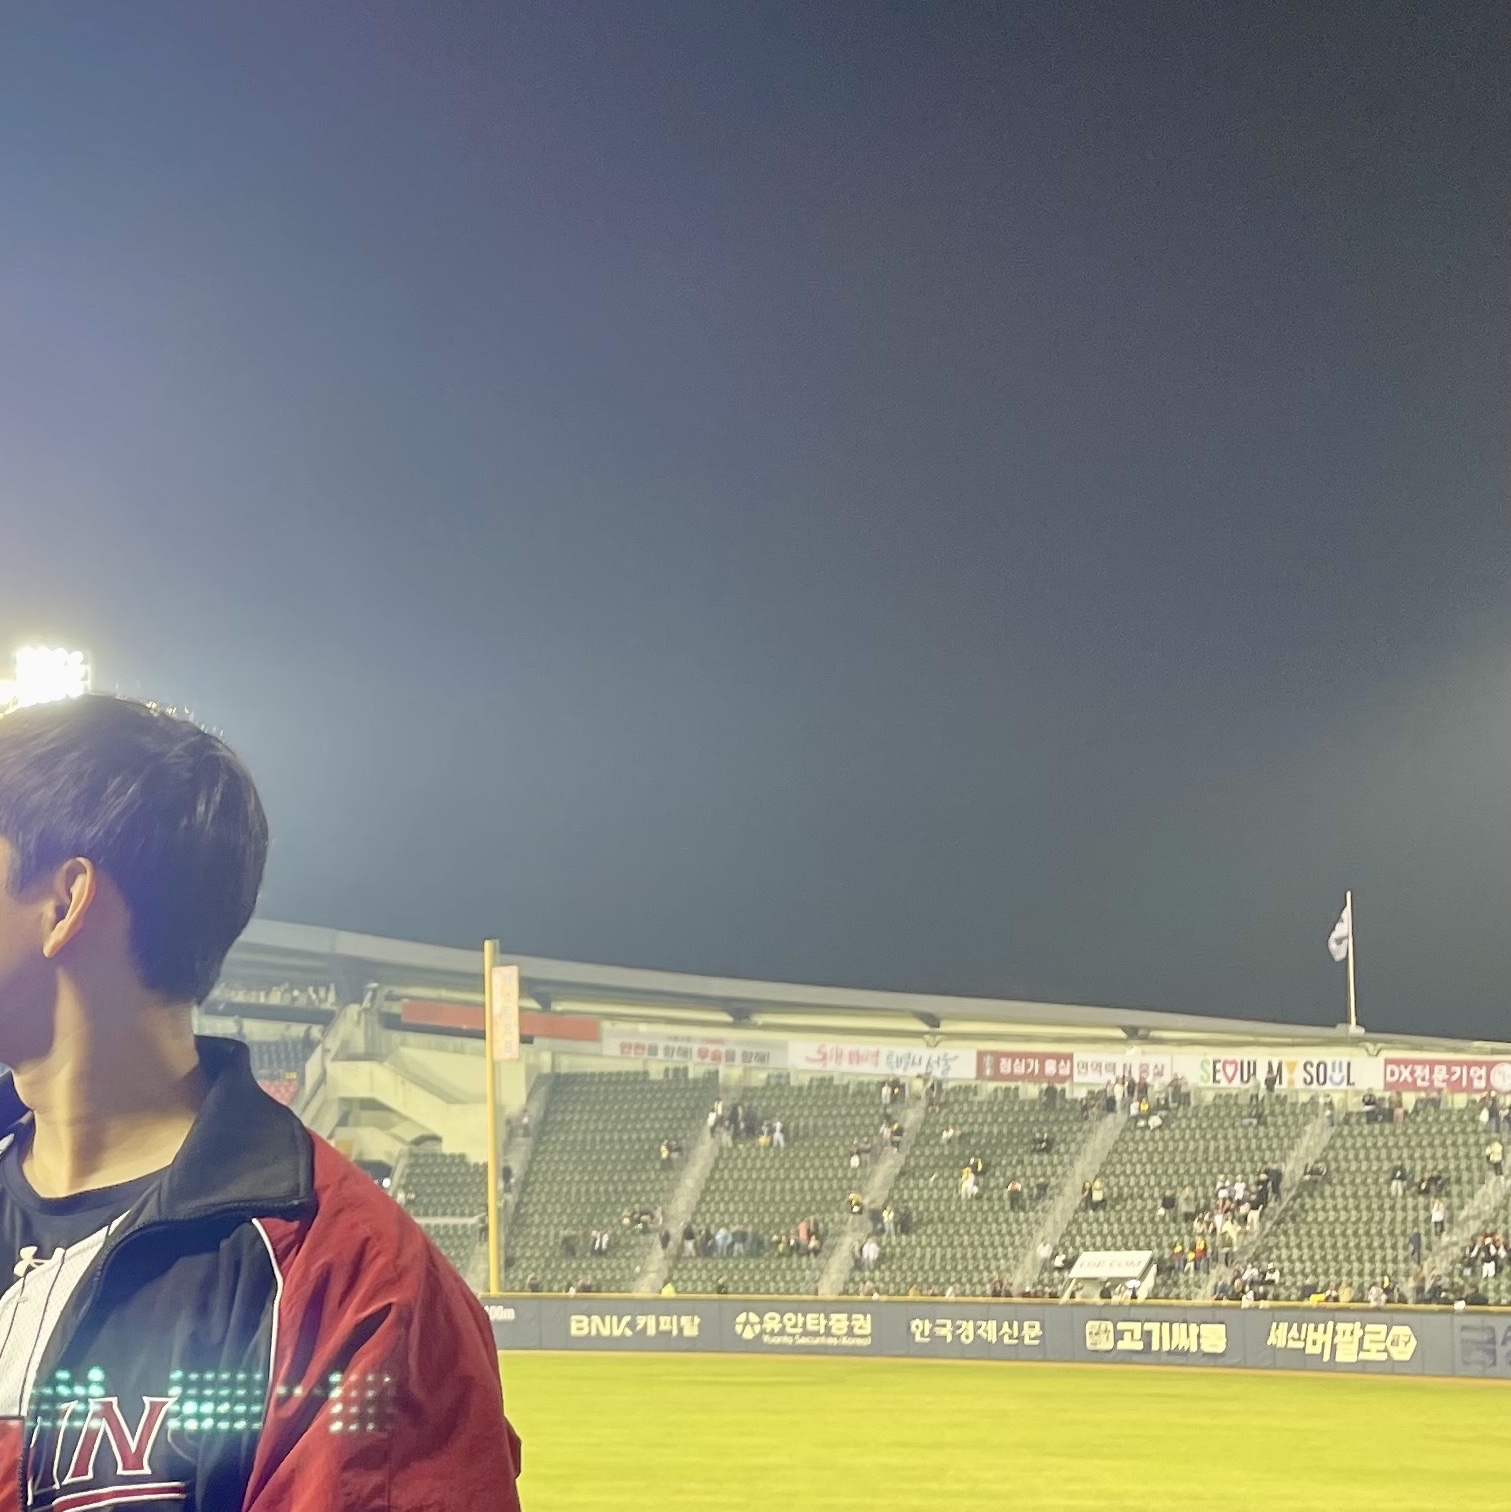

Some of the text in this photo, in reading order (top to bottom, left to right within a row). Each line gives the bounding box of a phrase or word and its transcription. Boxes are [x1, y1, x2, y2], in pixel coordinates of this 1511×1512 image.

[1303, 1060, 1355, 1086] SOUL
[762, 1311, 872, 1335] 유안타증권
[910, 1318, 1043, 1345] 한국경제신문
